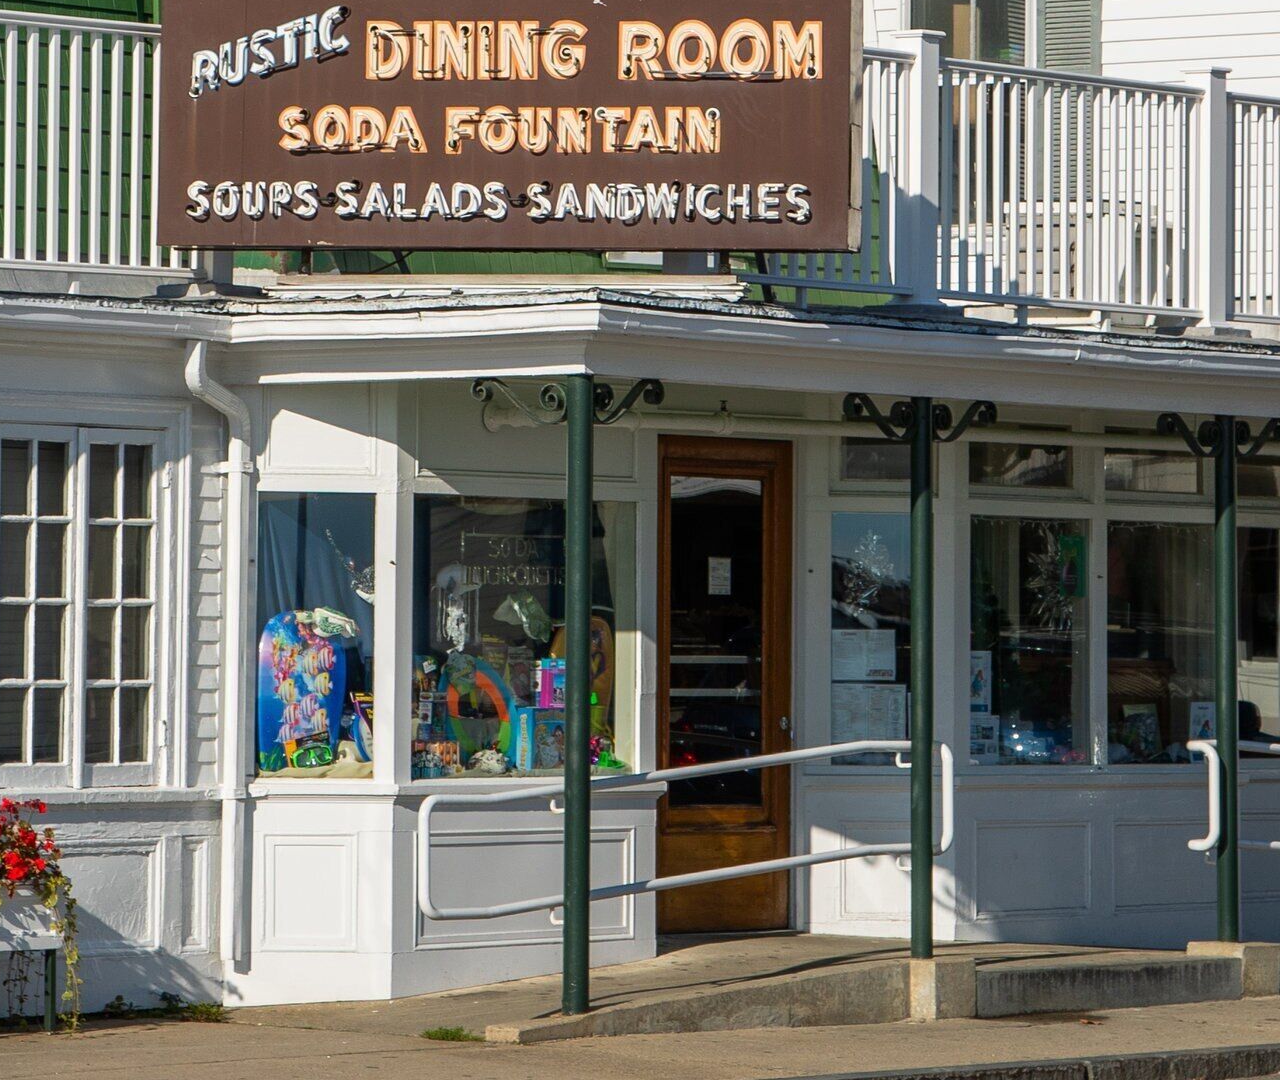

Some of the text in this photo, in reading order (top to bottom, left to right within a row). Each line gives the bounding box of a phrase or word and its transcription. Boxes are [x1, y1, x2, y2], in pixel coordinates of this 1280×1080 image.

[190, 5, 822, 98] RUSTIC DINING ROOM
[278, 104, 720, 154] SODA FOUNTAIN
[186, 180, 810, 221] SOUPS SALADS SANDWICHES
